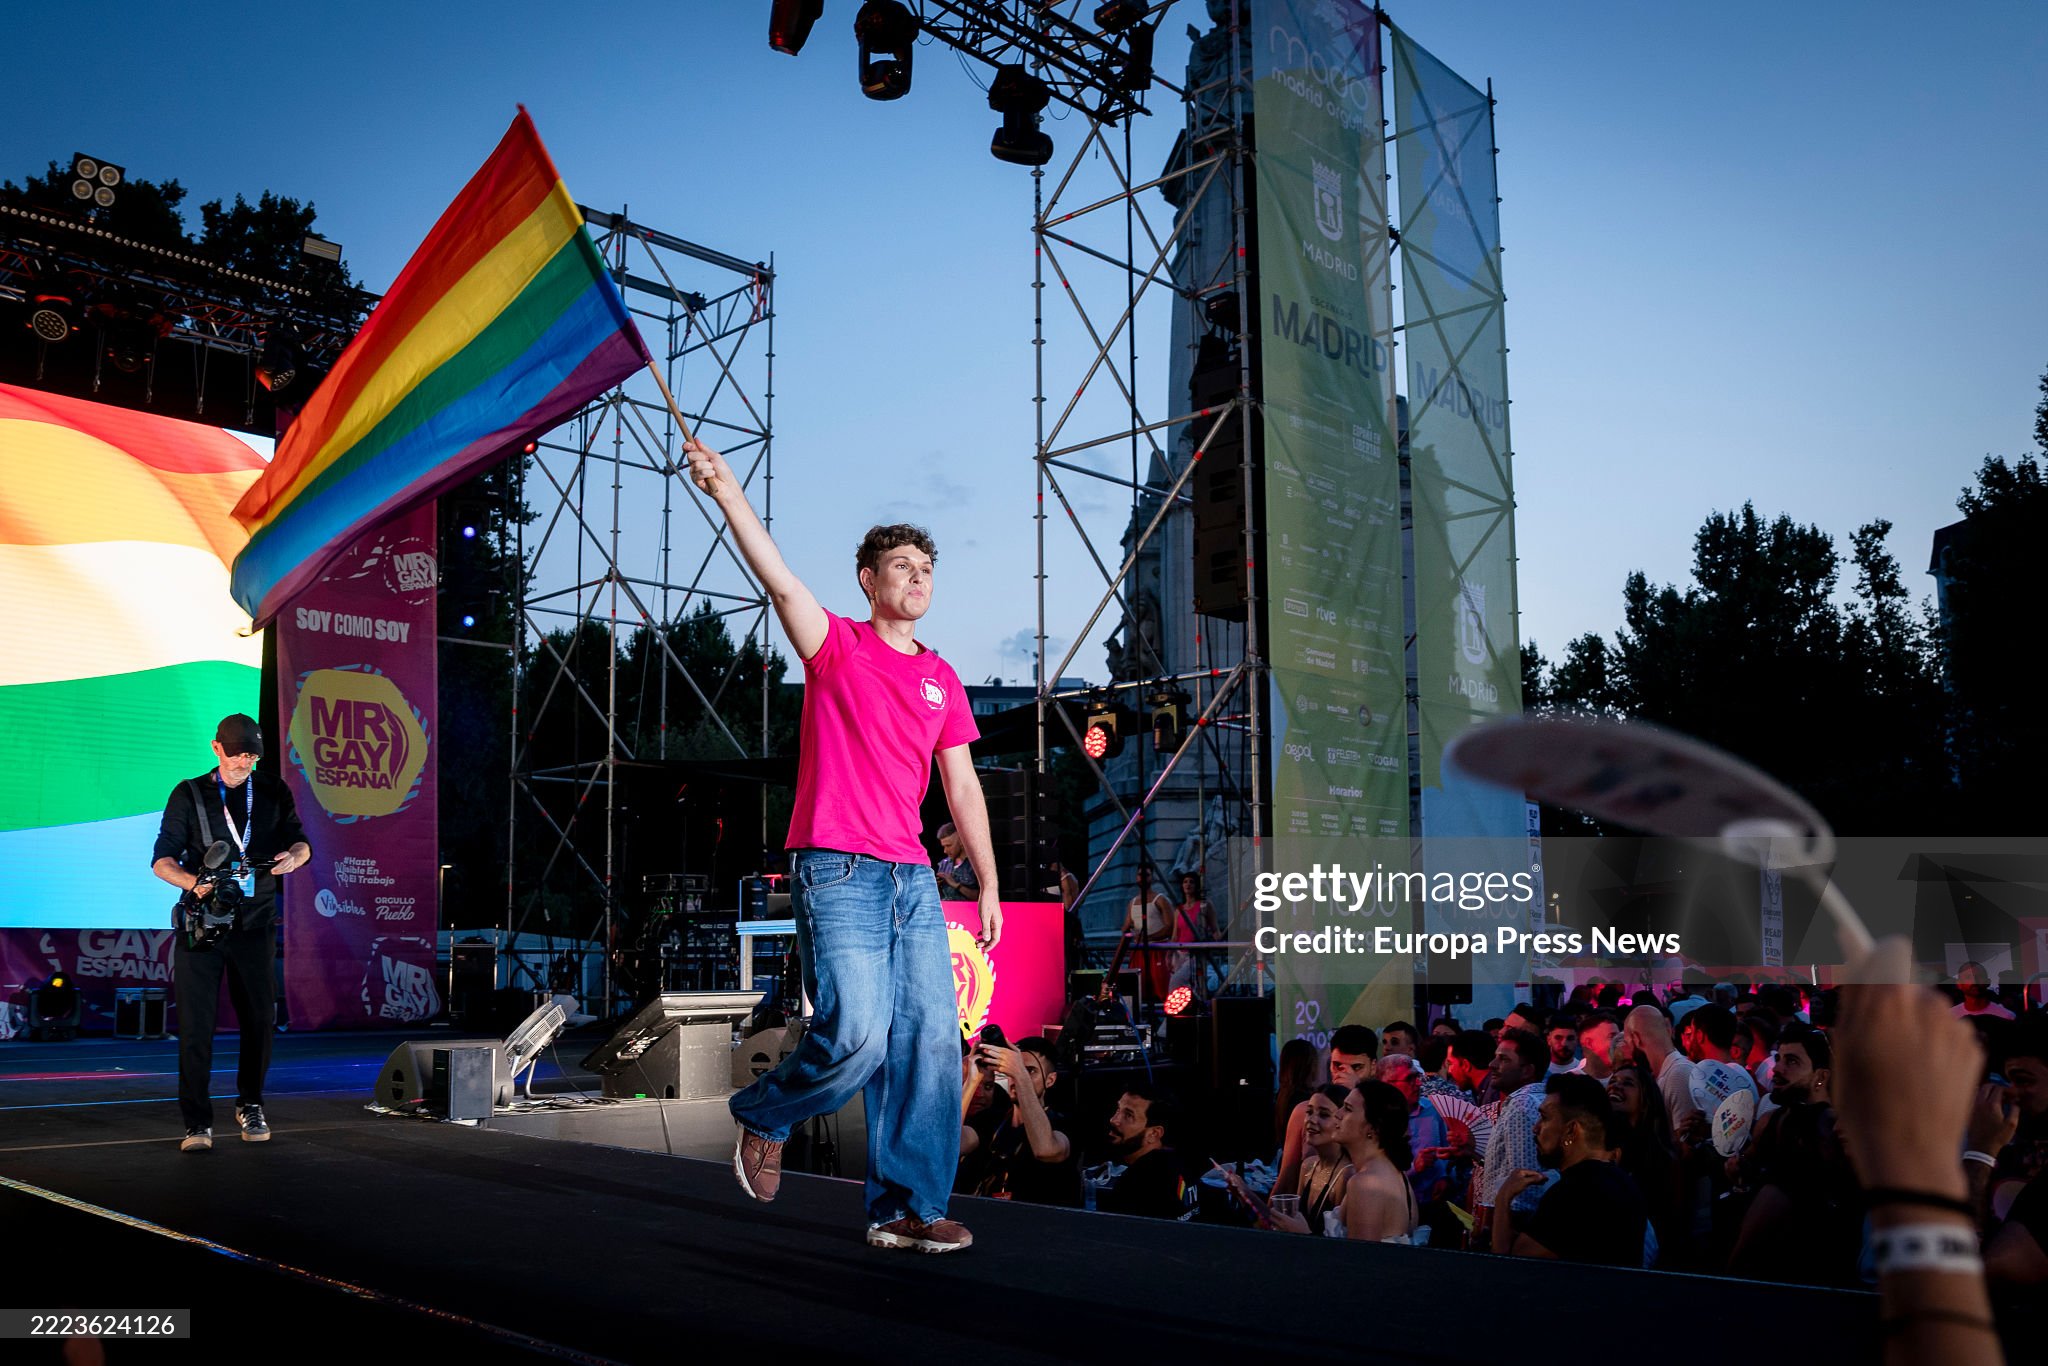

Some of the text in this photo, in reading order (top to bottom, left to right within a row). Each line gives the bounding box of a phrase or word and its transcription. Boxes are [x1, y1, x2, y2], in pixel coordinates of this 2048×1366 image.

[1271, 66, 1324, 108] madrid
[1302, 239, 1358, 281] MADRID
[1272, 292, 1387, 379] MADRID
[1416, 360, 1505, 435] MADRID
[393, 551, 430, 572] MR
[397, 567, 431, 584] GAY
[296, 607, 410, 643] SOY COMO SOY
[1316, 606, 1337, 626] rtve
[1448, 674, 1498, 703] MADRID
[310, 695, 390, 743] MR
[313, 736, 390, 772] GAY
[315, 766, 393, 790] ESPAÑA
[1329, 785, 1363, 799] Horarios
[343, 856, 376, 867] #Hazte
[366, 866, 379, 876] En
[349, 875, 395, 887] El Trabajo
[375, 897, 415, 905] ORGULLO
[375, 905, 415, 921] Pueblo
[78, 930, 176, 962] GAY
[76, 955, 169, 982] ESPAÑA
[382, 954, 429, 999] MR
[385, 983, 429, 1018] GAY
[1704, 1081, 1728, 1102] TENG
[1187, 1184, 1198, 1204] TV
